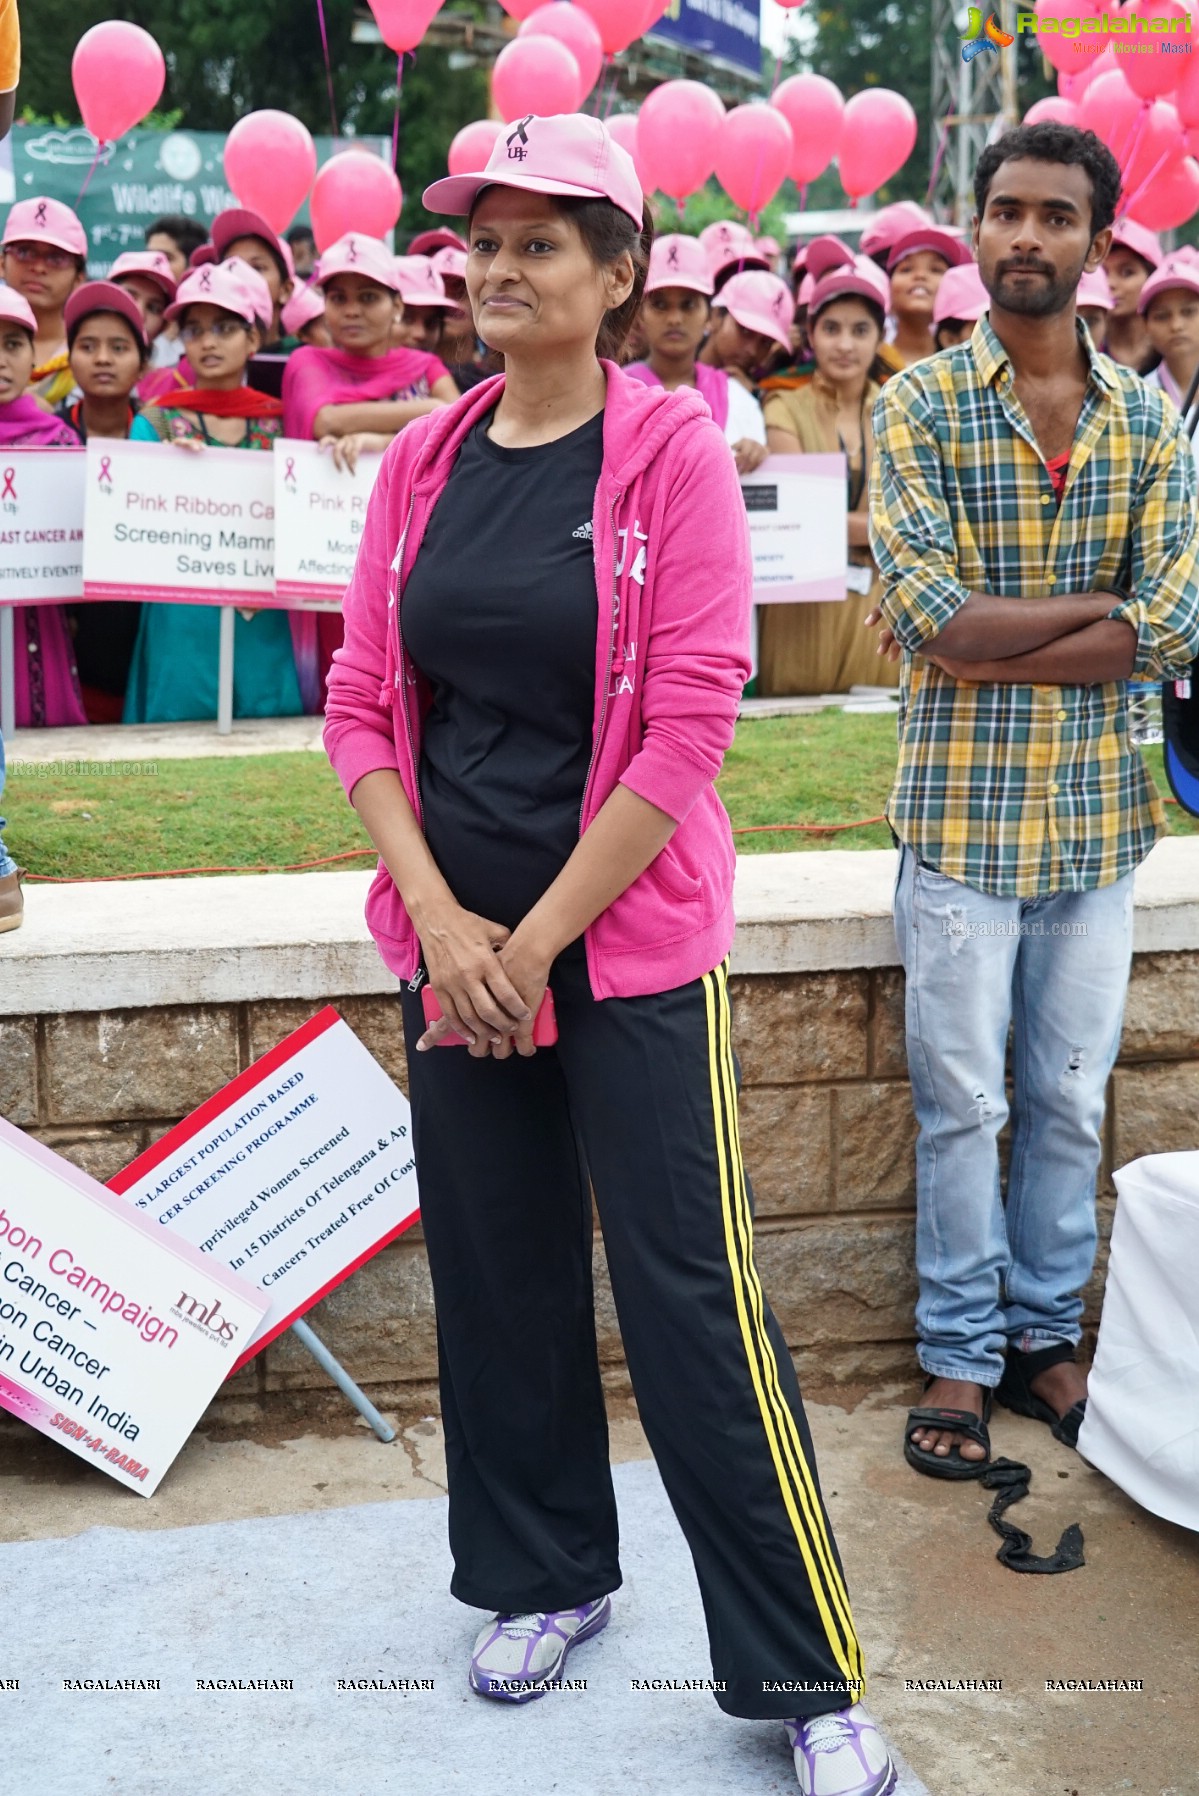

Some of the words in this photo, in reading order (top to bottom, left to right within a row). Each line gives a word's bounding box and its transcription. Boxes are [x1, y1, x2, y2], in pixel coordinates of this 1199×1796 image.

[111, 182, 197, 215] Wildlife
[126, 491, 168, 514] Pink
[175, 495, 243, 518] Ribbon
[309, 492, 345, 513] Pink
[24, 529, 66, 544] CANCER
[114, 522, 212, 552] Screening
[177, 554, 236, 577] Saves
[148, 1153, 199, 1202] LARGEST
[198, 1100, 269, 1160] POPULATION
[268, 1070, 305, 1105] BASED
[183, 1150, 247, 1206] SCREENING
[245, 1092, 320, 1154] PROGRAMME
[257, 1166, 301, 1205] Women
[299, 1125, 351, 1169] Screened
[228, 1252, 246, 1272] In
[243, 1241, 260, 1261] 15
[258, 1204, 306, 1247] Districts
[304, 1189, 323, 1208] Of
[319, 1147, 378, 1197] Telengana
[377, 1138, 390, 1151] &
[390, 1124, 408, 1142] Ap
[261, 1241, 309, 1287] Cancers
[305, 1209, 357, 1252] Treated
[348, 1194, 375, 1217] Free
[374, 1176, 392, 1196] Of
[3, 1261, 82, 1321] Cancer
[48, 1248, 179, 1349] Campaign
[174, 1290, 239, 1341] mbs
[32, 1320, 111, 1380] Cancer
[19, 1350, 84, 1406] Urban
[87, 1395, 141, 1442] India
